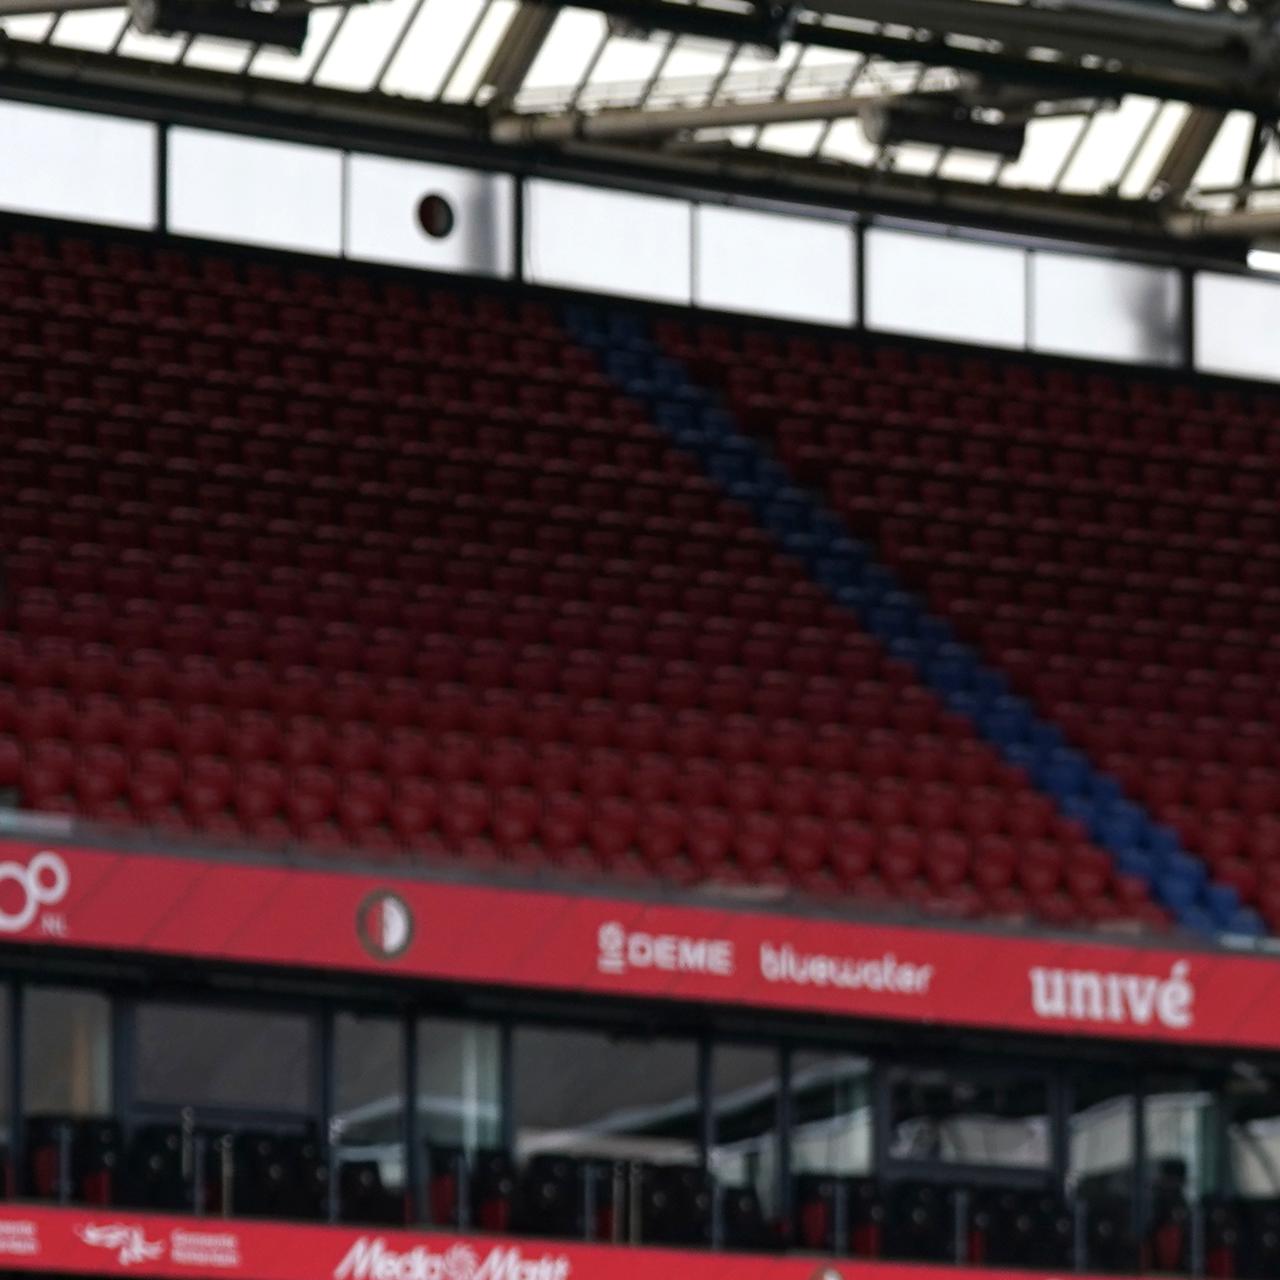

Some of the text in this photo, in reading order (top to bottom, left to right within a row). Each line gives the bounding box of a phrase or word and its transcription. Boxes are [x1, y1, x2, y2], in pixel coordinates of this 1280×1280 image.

[627, 932, 734, 976] DEME
[760, 940, 935, 995] bluewater
[1029, 959, 1193, 1030] univé
